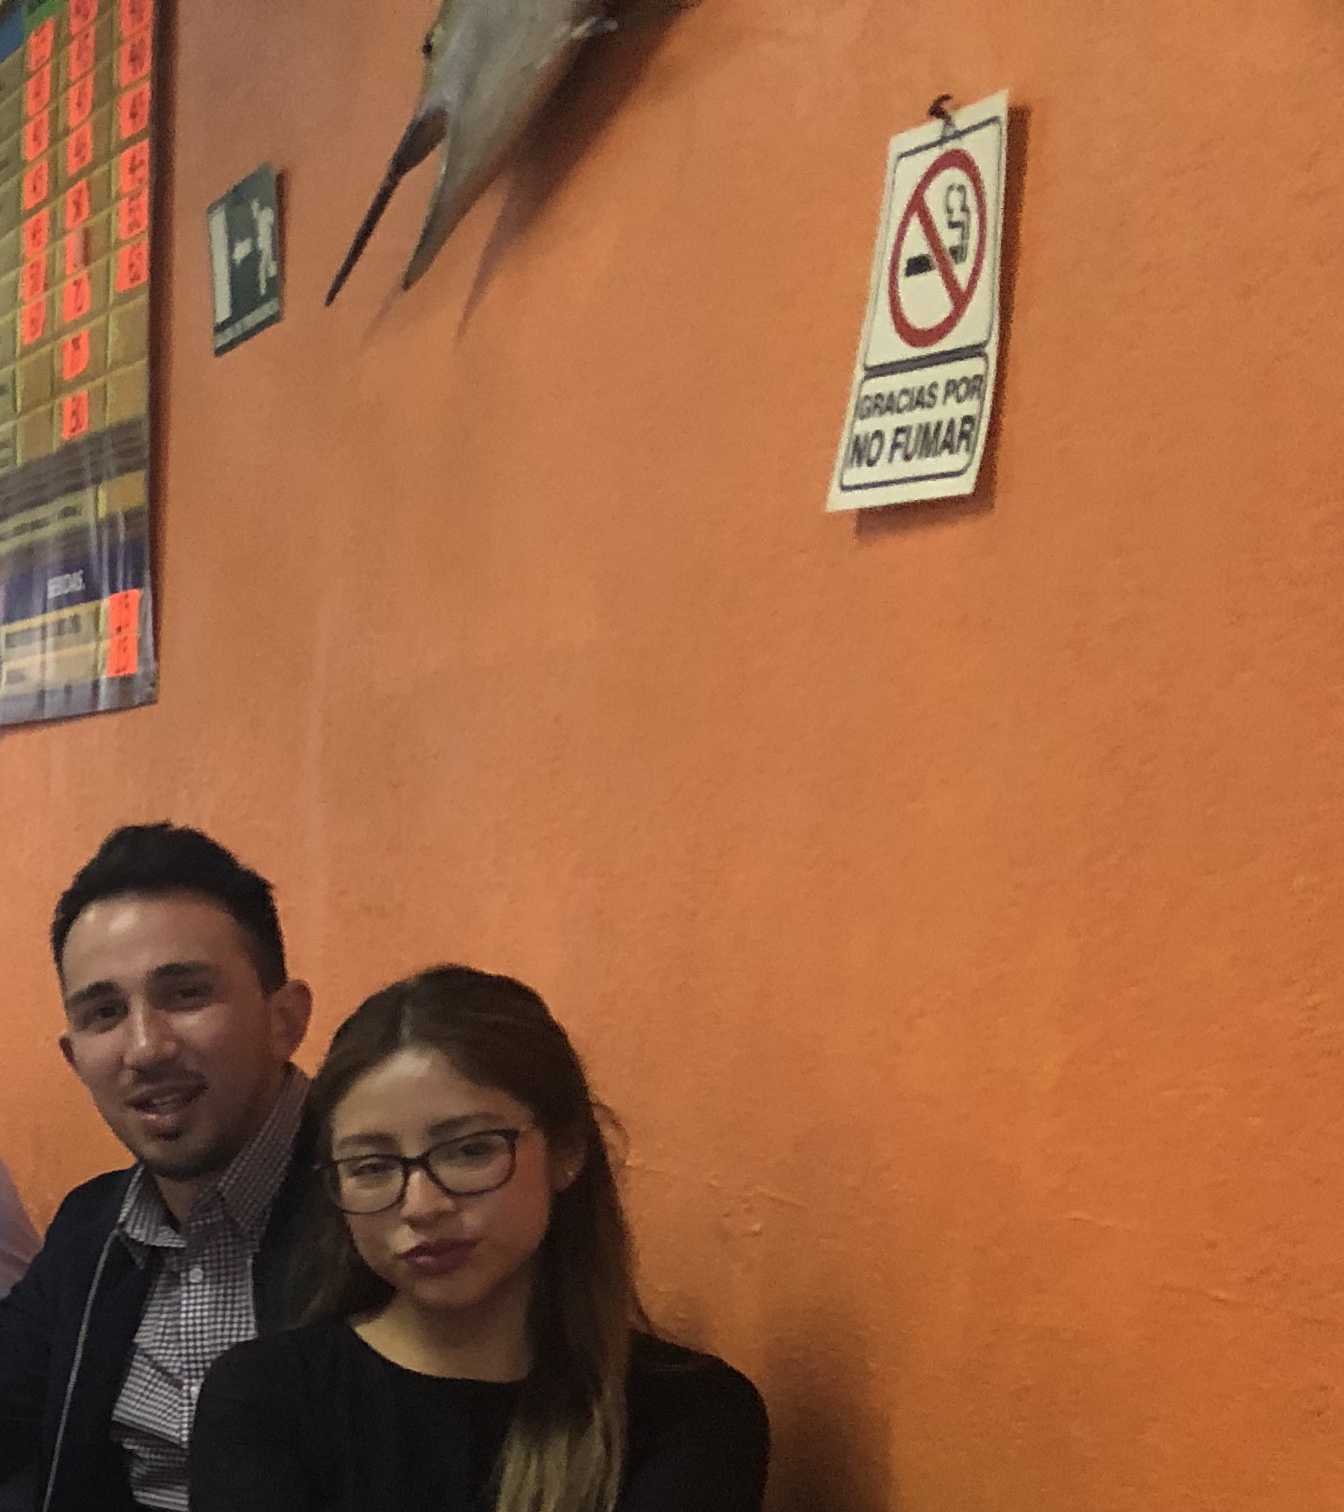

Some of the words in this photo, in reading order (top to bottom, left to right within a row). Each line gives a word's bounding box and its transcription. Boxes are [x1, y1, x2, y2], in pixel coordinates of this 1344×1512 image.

[858, 380, 939, 420] GRACIAS
[944, 374, 984, 405] POR
[850, 429, 884, 468] NO
[888, 414, 975, 464] FUMAR
